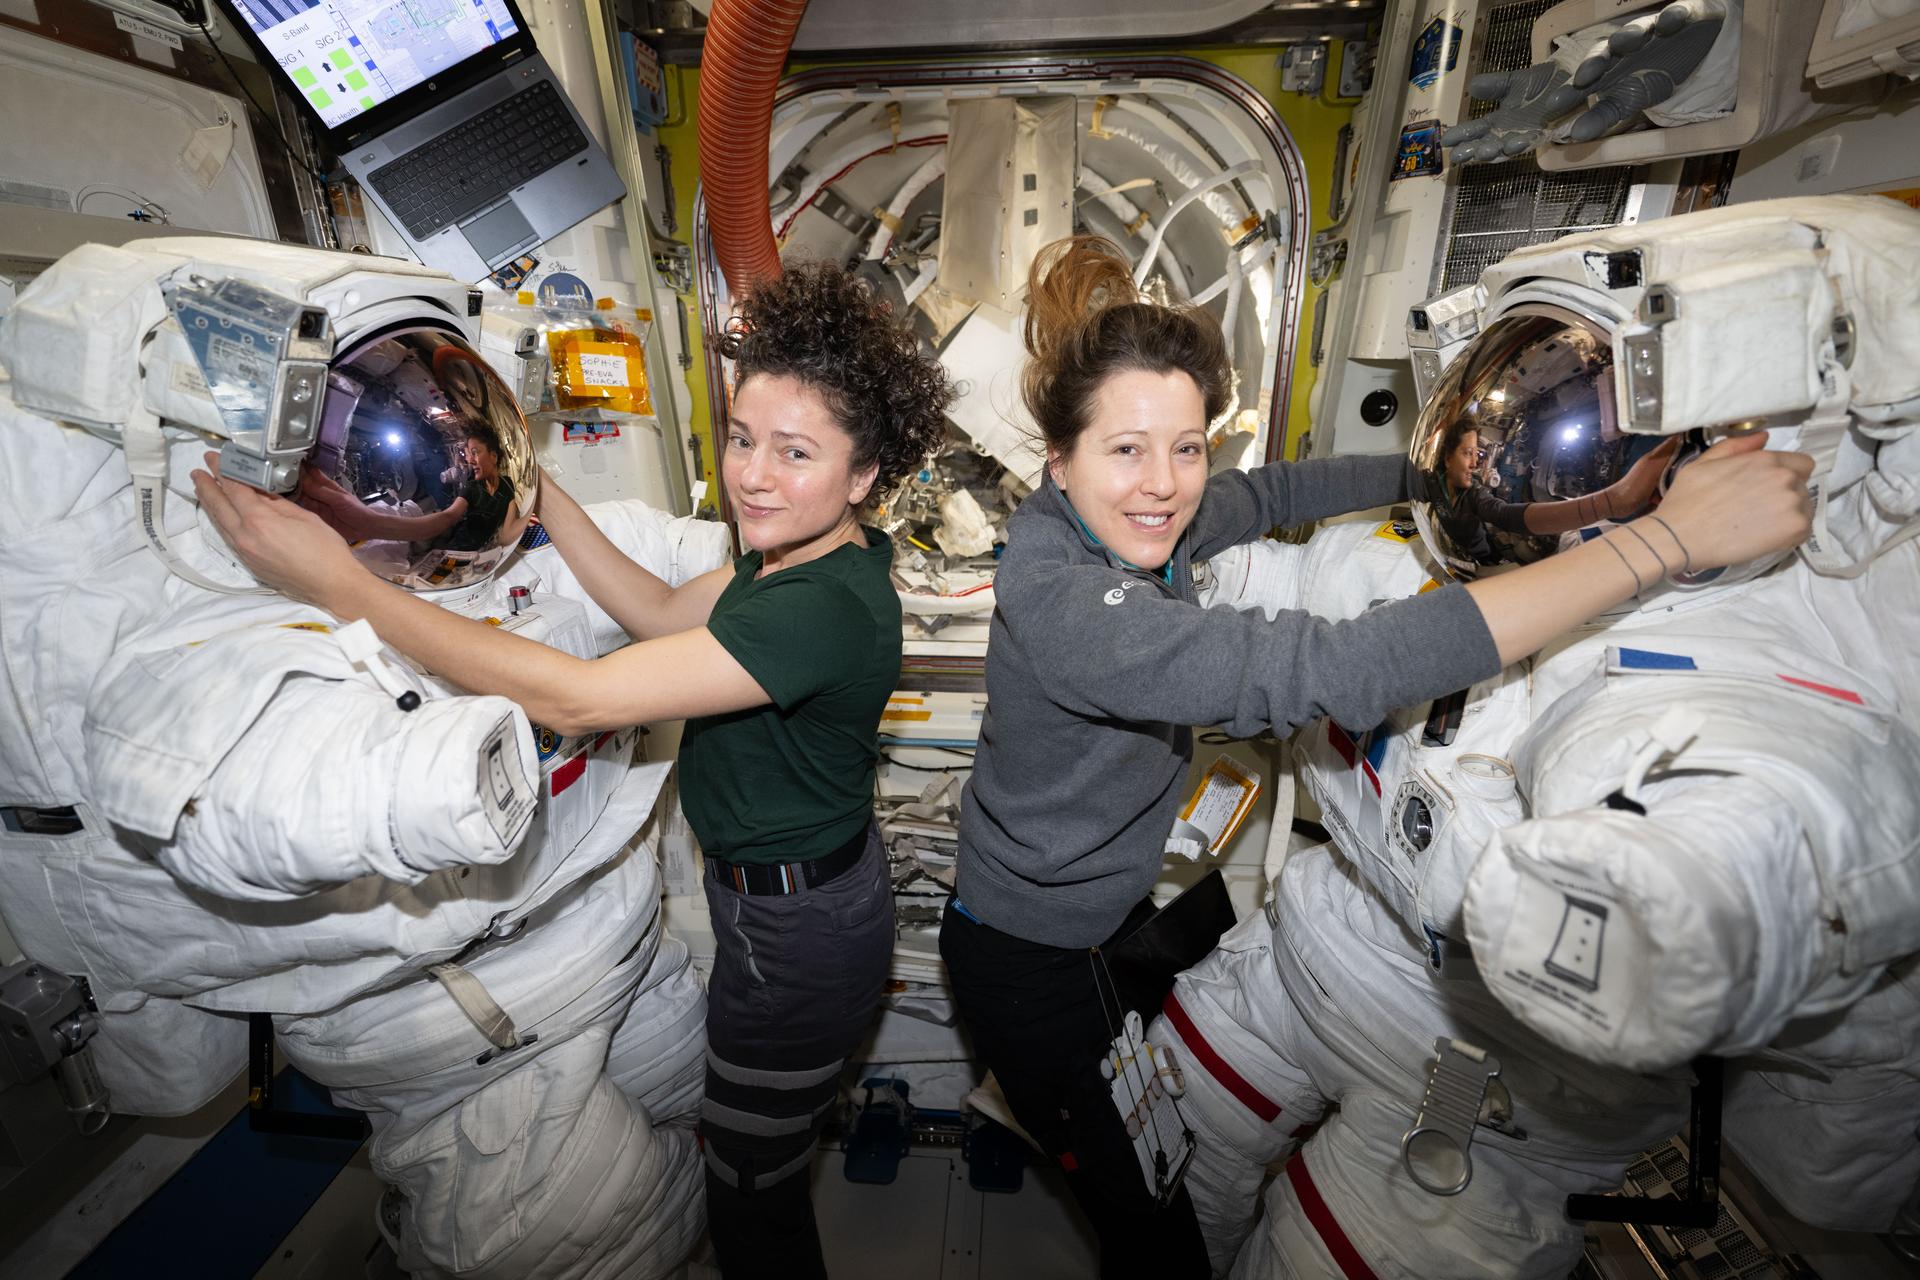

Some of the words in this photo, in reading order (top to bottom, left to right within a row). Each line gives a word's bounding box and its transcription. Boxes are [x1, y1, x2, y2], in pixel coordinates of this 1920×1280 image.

[282, 22, 310, 41] S-Band
[315, 34, 335, 49] S/G
[333, 30, 343, 41] 2
[277, 53, 297, 68] S/G
[298, 49, 305, 58] 1
[336, 106, 360, 121] Health
[585, 377, 625, 387] SNACKS
